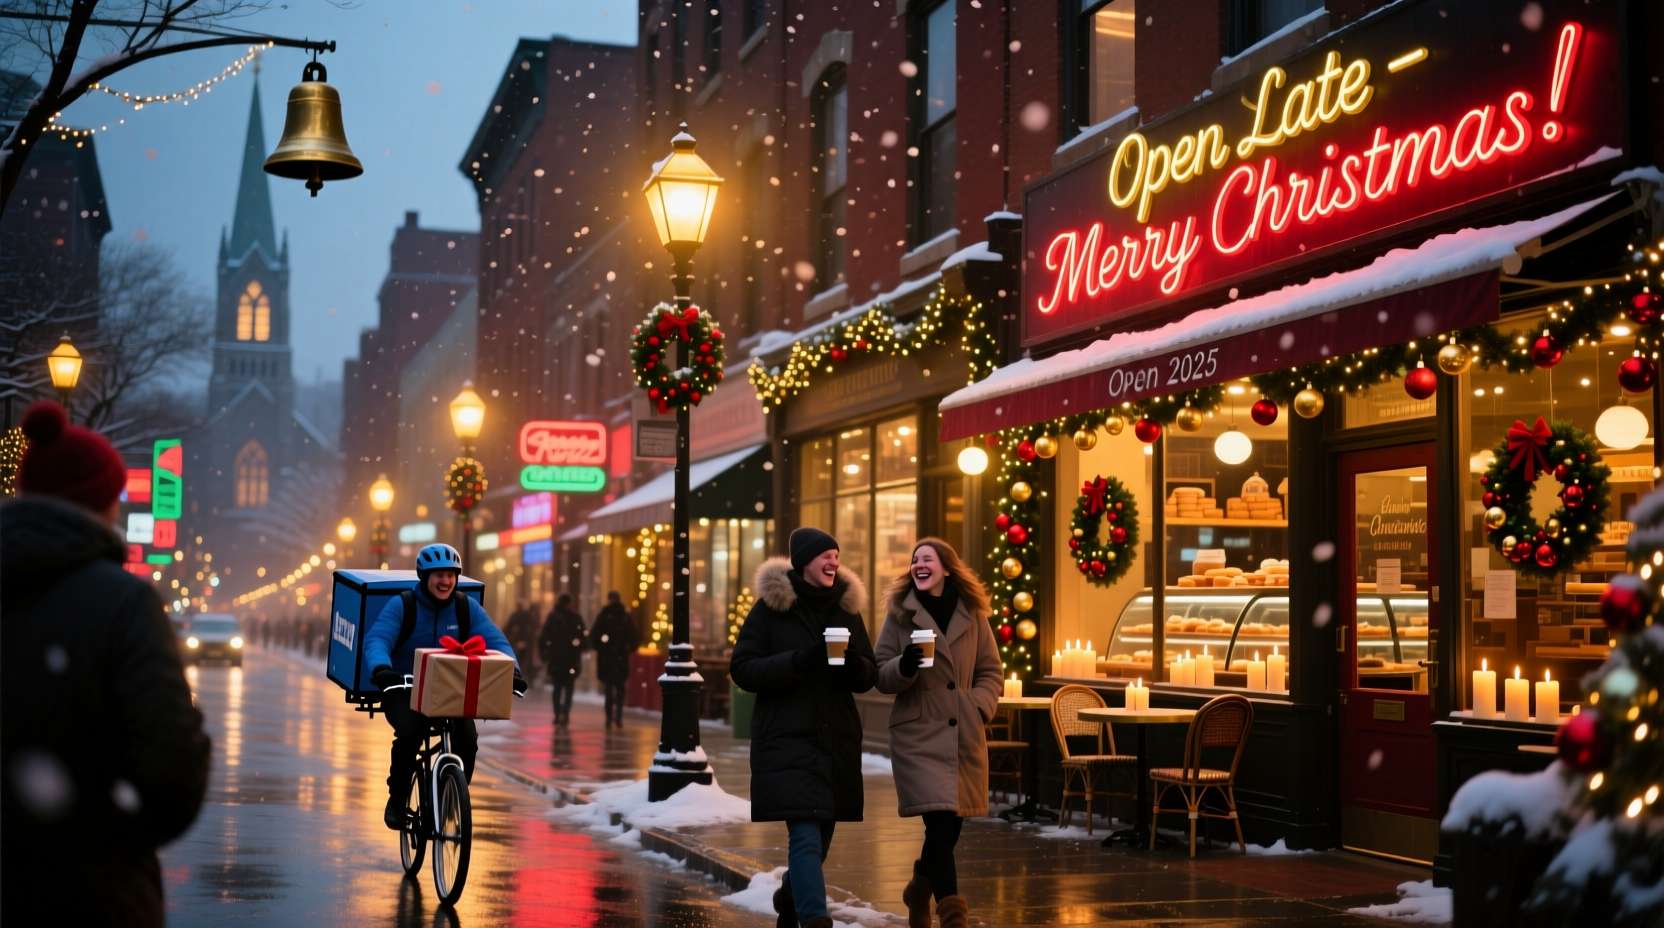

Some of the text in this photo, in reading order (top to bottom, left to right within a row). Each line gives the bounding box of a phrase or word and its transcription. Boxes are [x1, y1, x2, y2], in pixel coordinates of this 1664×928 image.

[1037, 21, 1584, 313] Merry Christmas!
[1108, 124, 1230, 223] Open
[1237, 50, 1374, 159] Late
[1108, 347, 1219, 398] Open 2025
